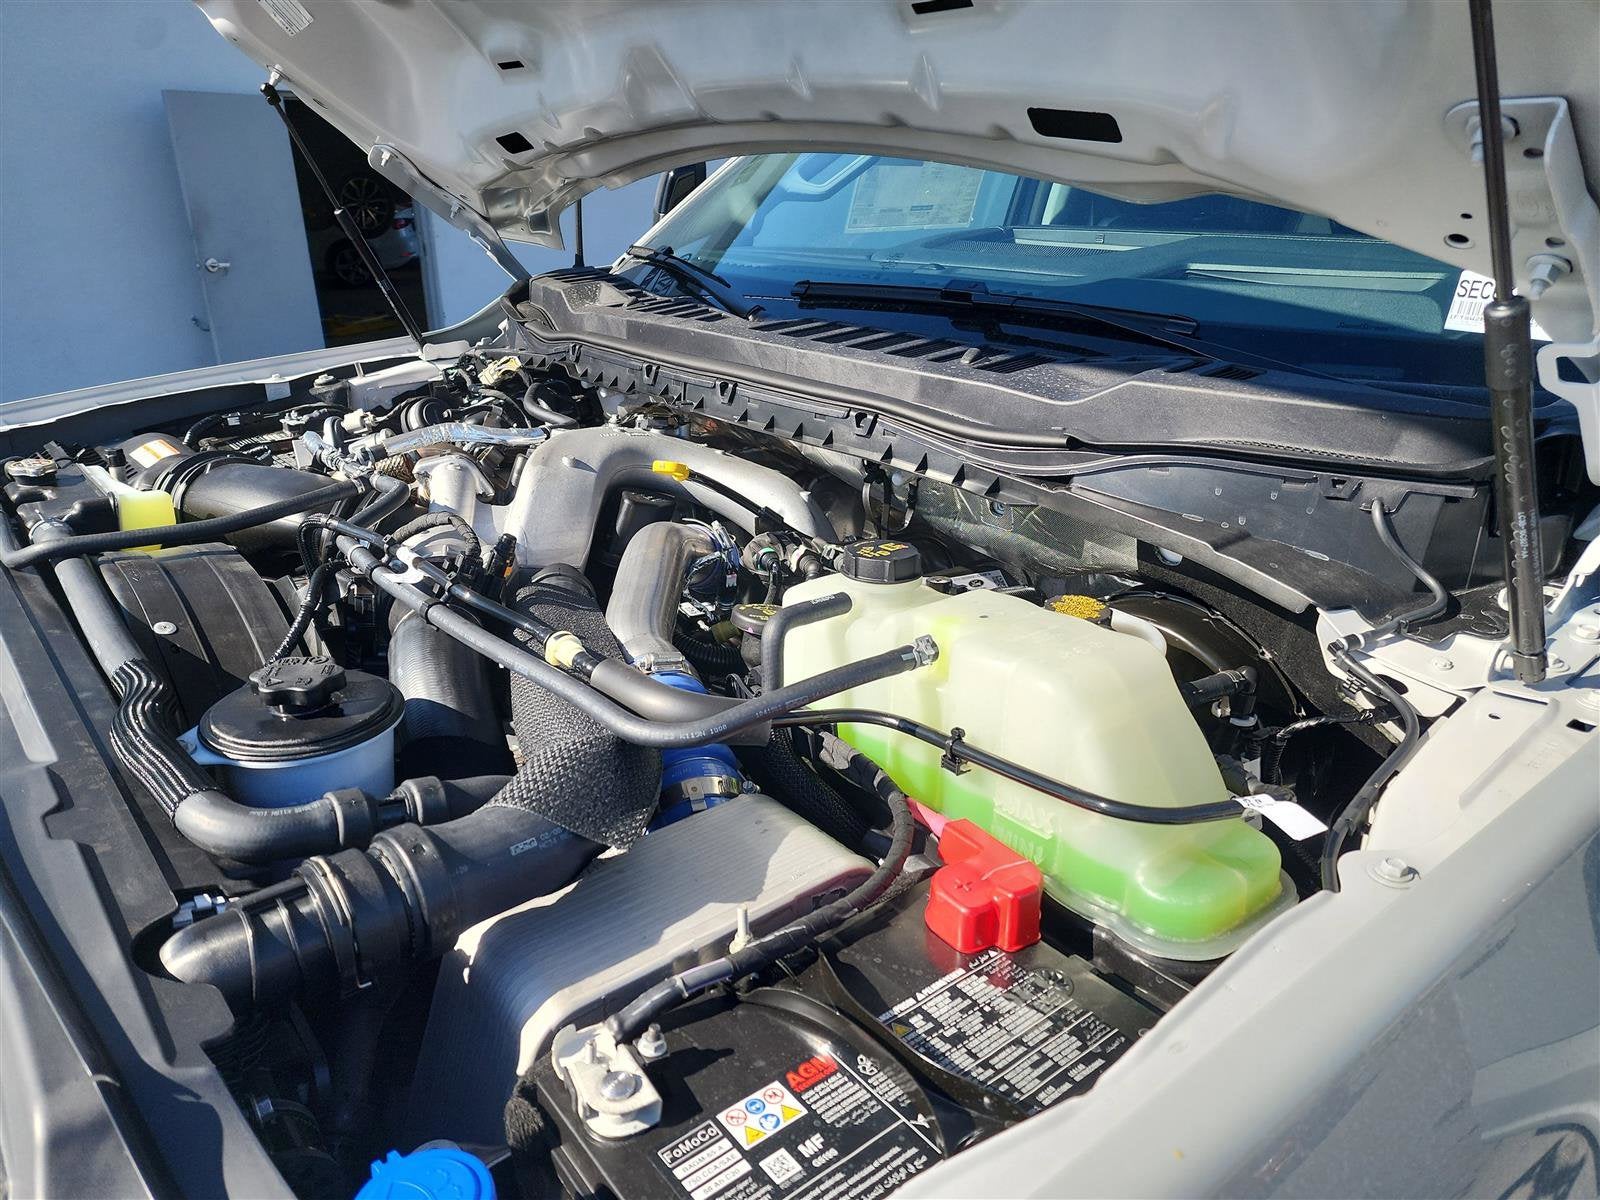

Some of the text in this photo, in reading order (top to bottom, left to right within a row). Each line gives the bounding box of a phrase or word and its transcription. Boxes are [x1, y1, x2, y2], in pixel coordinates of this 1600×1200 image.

[1457, 280, 1496, 299] SEC
[662, 1127, 718, 1163] FoMoCo
[797, 1132, 825, 1158] MF
